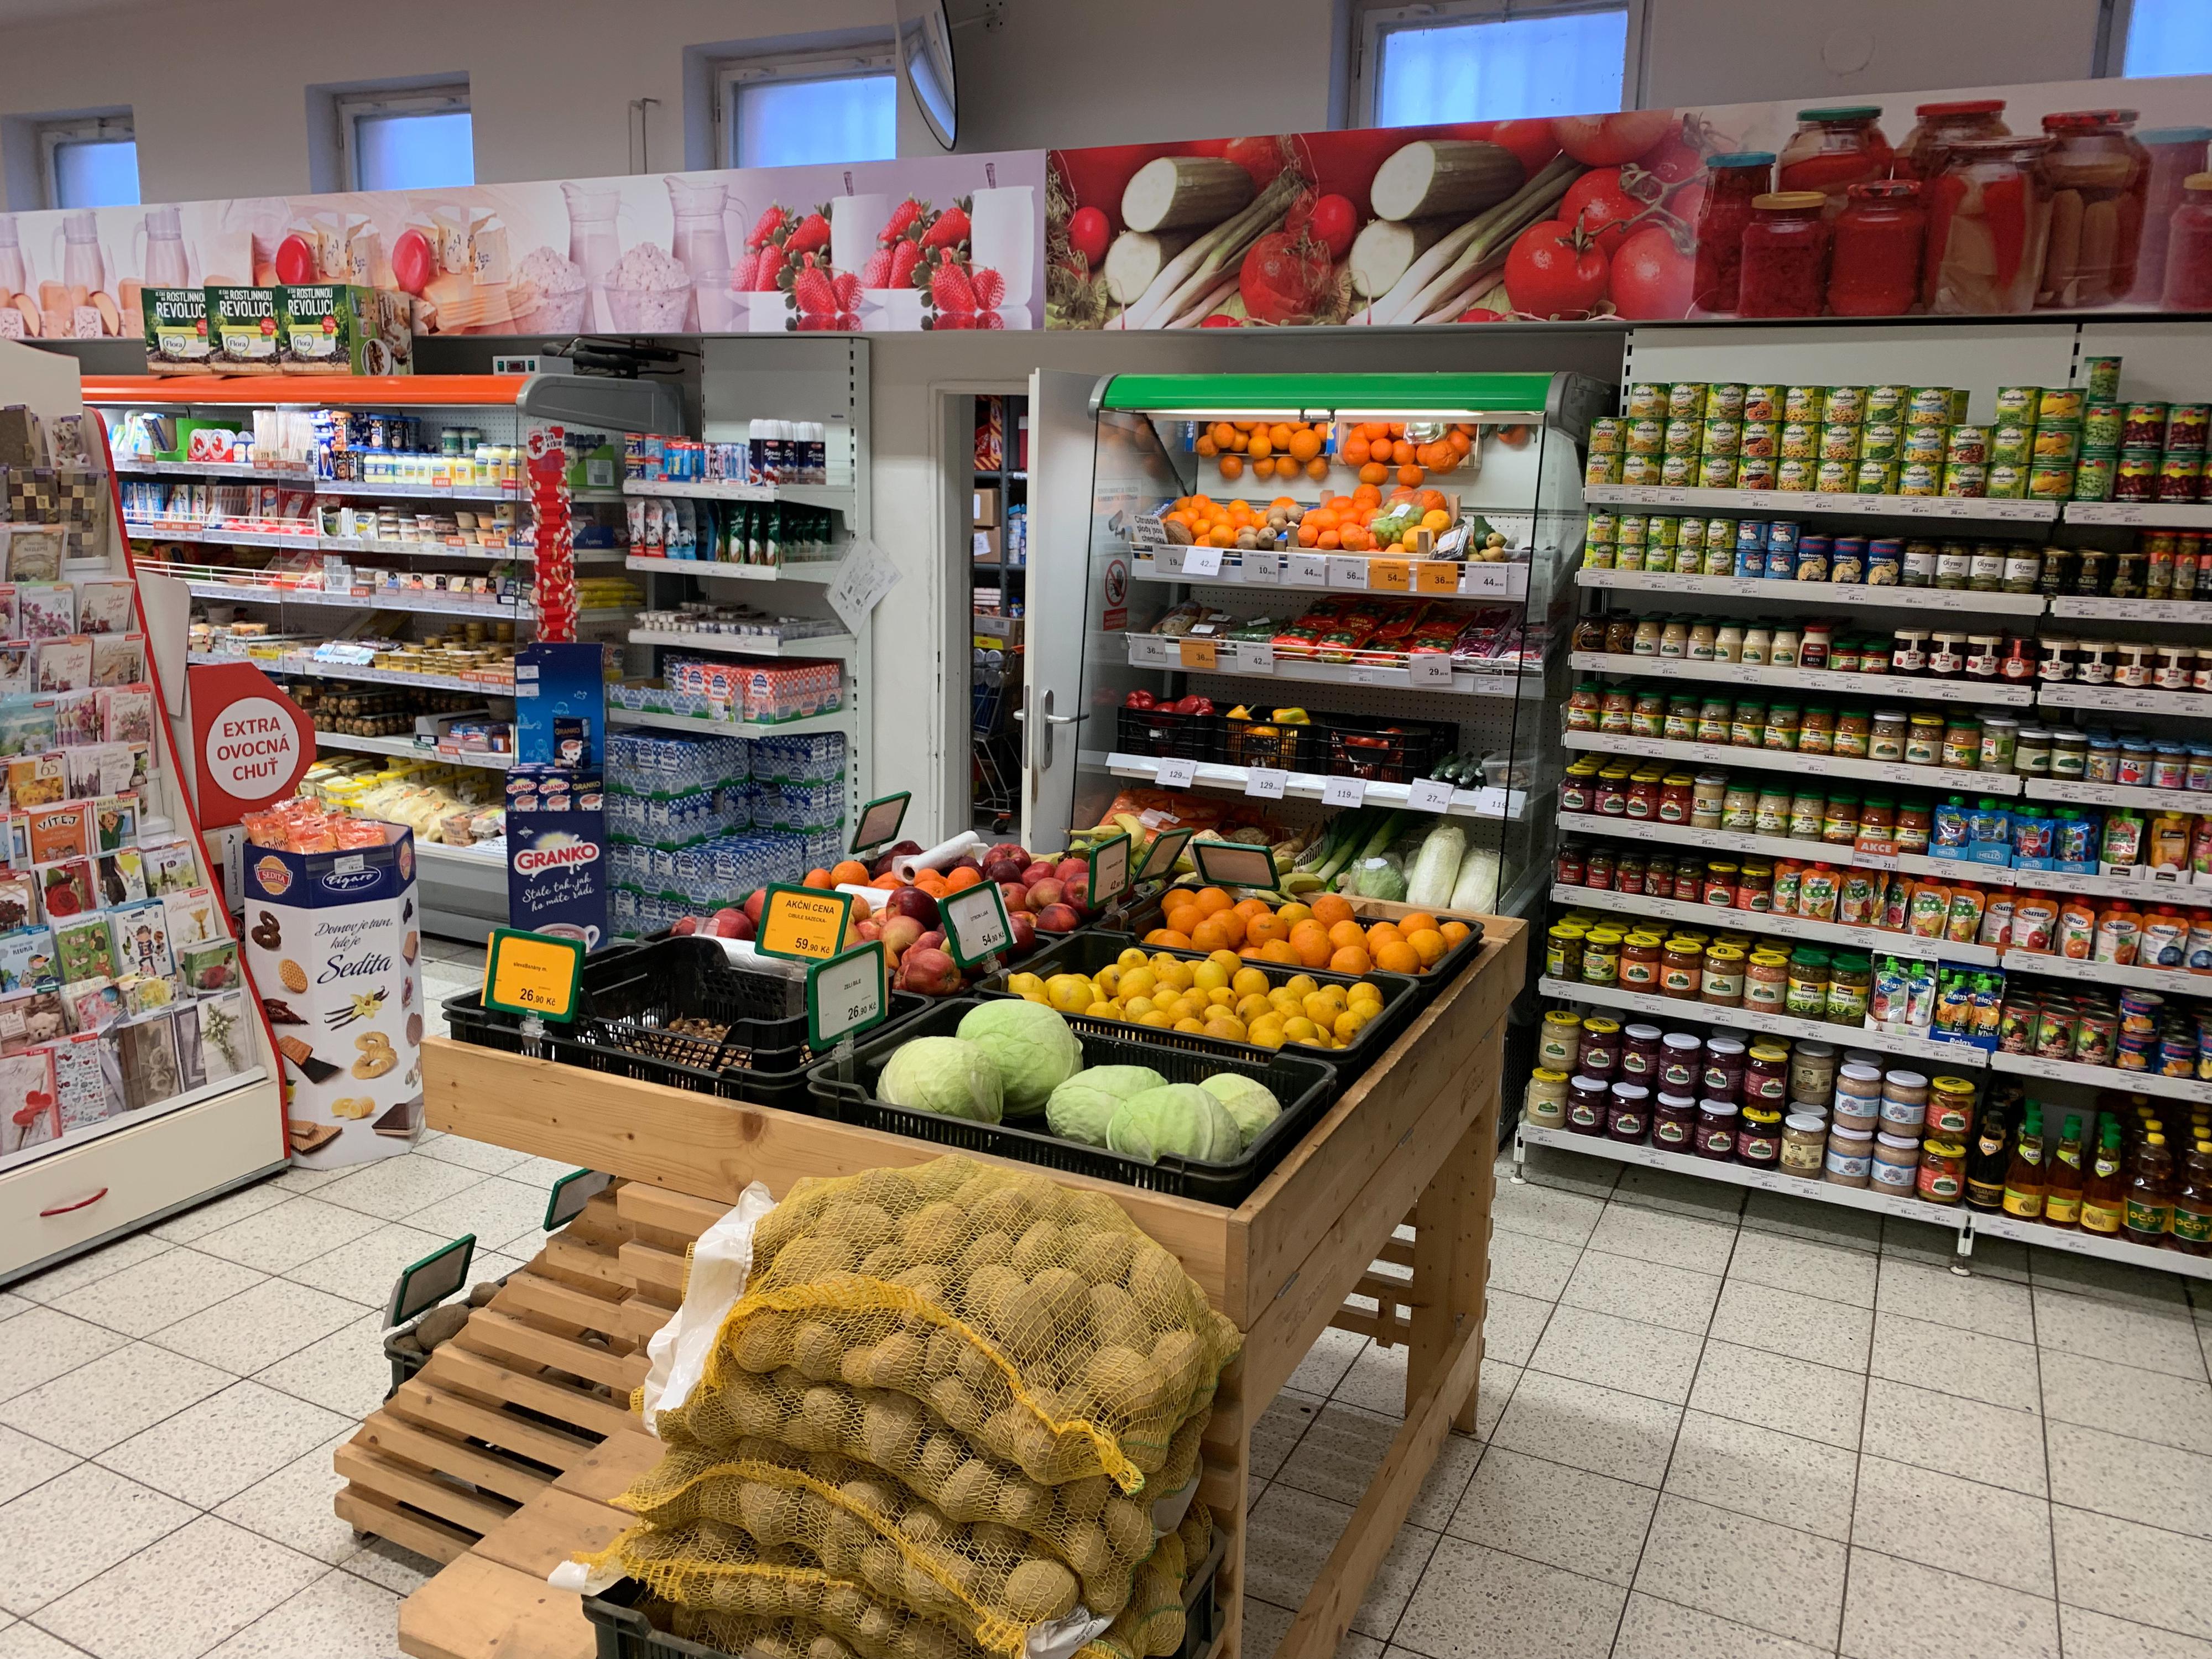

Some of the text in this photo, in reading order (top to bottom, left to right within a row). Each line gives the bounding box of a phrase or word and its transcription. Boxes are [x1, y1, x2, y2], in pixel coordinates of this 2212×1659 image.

[166, 291, 205, 302] ROSTLINNO
[156, 302, 206, 319] REVOLUC
[166, 340, 182, 349] Flora
[230, 340, 246, 348] Flora
[296, 339, 311, 347] Flora
[1943, 558, 1963, 567] Olymp
[1978, 560, 1997, 568] Olymp
[2015, 562, 2034, 571] Olymp
[223, 718, 281, 738] EXTRA
[217, 734, 290, 762] OVOCNÁ
[41, 761, 58, 776] 65
[232, 760, 278, 781] CHUŤ
[507, 782, 536, 792] GRANKO
[540, 782, 568, 792] GRANKO
[572, 781, 601, 790] GRANKO
[38, 815, 78, 830] VÍTEJ
[1861, 842, 1892, 853] AKCE
[517, 844, 597, 870] GRANKO
[262, 870, 286, 884] SEDITA
[326, 873, 377, 889] Figaro
[523, 888, 551, 904] Stále
[786, 900, 834, 914] AKČNÍ CENA
[2022, 909, 2048, 918] Sunar
[315, 922, 356, 937] Domov
[2107, 922, 2133, 931] Sunar
[2152, 926, 2179, 936] Sunar
[330, 936, 361, 951] kde je
[795, 937, 830, 954] 59,90 Kč
[982, 933, 998, 946] 54,90
[316, 952, 393, 985] Sedita
[520, 988, 556, 1006] 26,90 Kč
[1948, 992, 1968, 1001] Relax
[848, 1003, 877, 1020] 26,90 Kč
